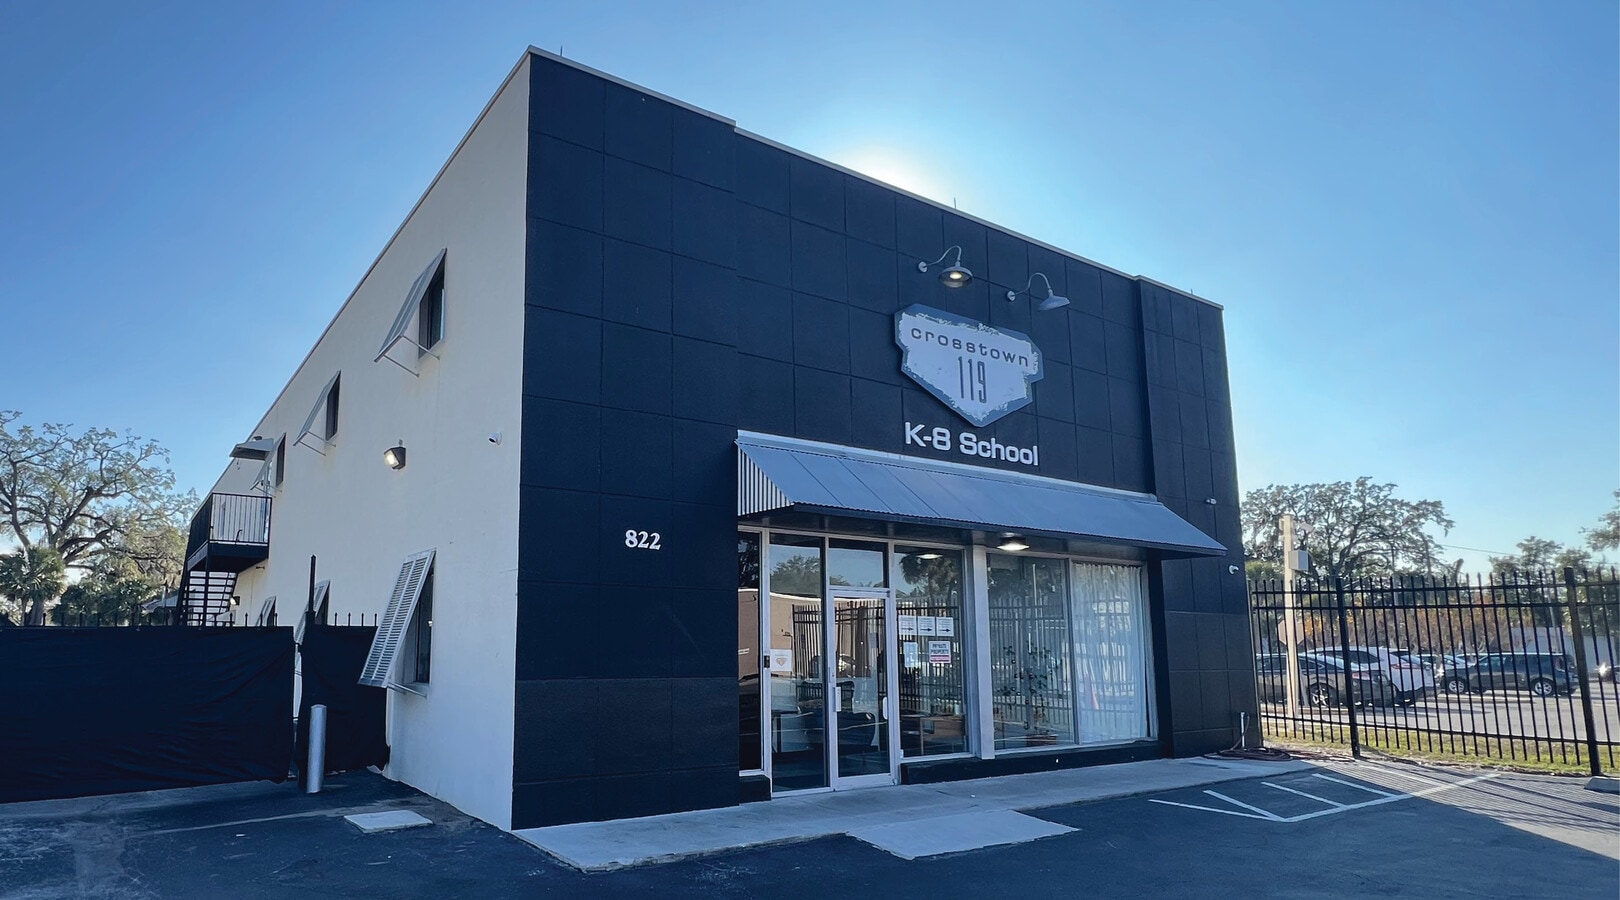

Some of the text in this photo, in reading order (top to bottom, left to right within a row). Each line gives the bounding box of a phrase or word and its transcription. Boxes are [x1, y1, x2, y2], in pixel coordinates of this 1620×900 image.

[911, 328, 1028, 367] crosstown
[958, 356, 987, 403] 119
[905, 422, 1039, 466] K-8 School
[625, 530, 661, 550] 822
